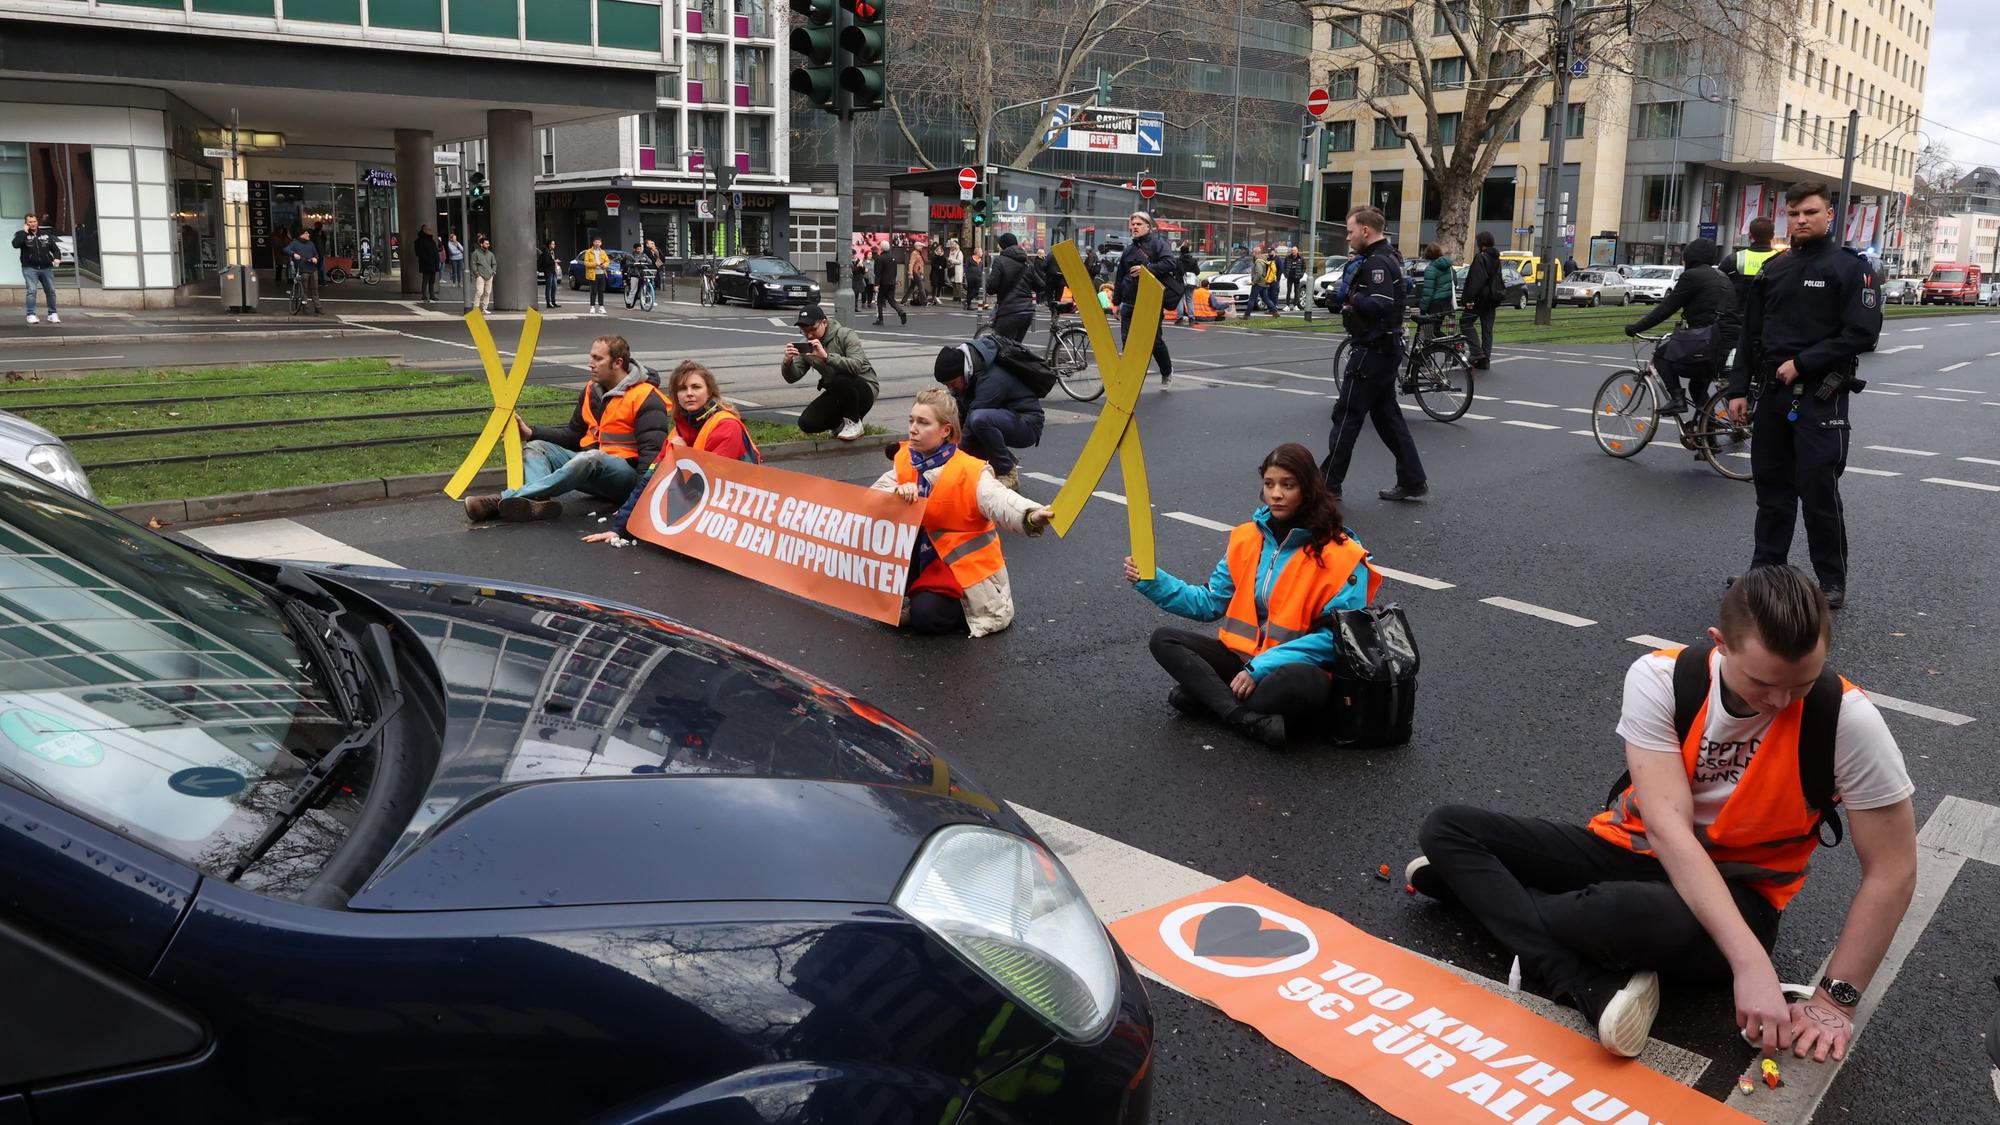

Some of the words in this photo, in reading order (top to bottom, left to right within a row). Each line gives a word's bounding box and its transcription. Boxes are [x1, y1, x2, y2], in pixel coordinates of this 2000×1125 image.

[1096, 114, 1132, 131] SATURN
[1090, 134, 1115, 145] REWE
[370, 169, 393, 179] Service
[372, 177, 391, 187] Punkt
[1206, 185, 1243, 202] REWE
[1007, 195, 1018, 212] U
[1803, 279, 1825, 288] POLIZEI
[709, 478, 780, 523] LETZTE
[777, 496, 918, 560] GENERATION
[695, 510, 737, 544] VOR
[735, 522, 775, 556] DEN
[774, 534, 909, 597] KIPPPUNKTEN
[1277, 976, 1356, 1021] 9€
[1343, 1012, 1458, 1080] FÜR
[1318, 960, 1415, 1012] 100
[1407, 1006, 1576, 1098] KM/H
